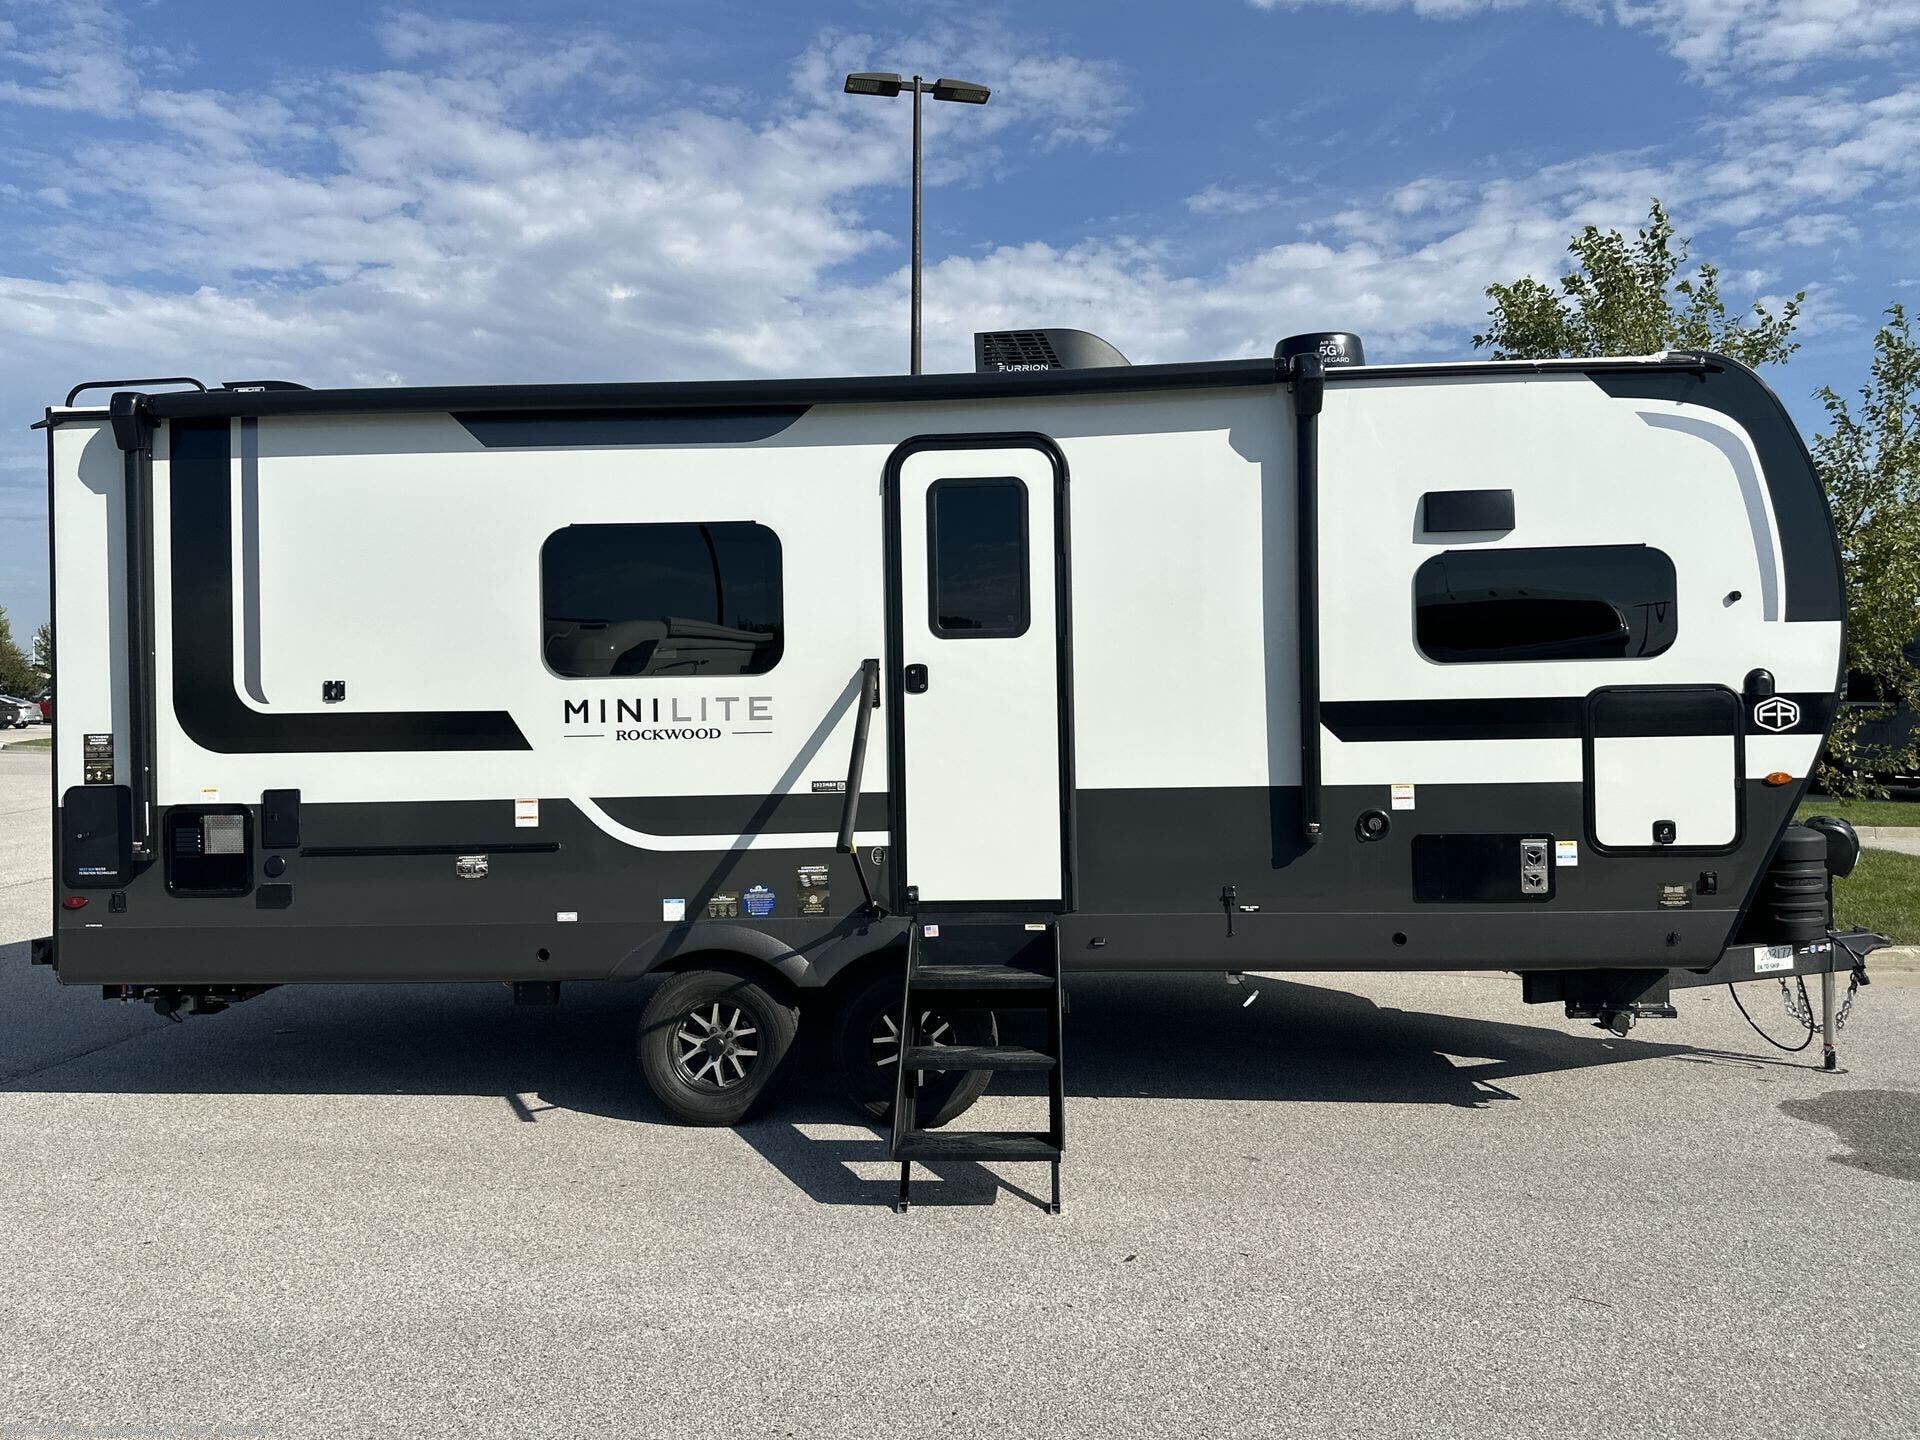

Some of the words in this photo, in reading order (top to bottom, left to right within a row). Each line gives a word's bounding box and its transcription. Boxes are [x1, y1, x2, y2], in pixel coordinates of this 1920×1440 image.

[1319, 345, 1337, 356] 5G
[999, 363, 1049, 372] FURRION
[615, 728, 722, 741] ROCKWOOD
